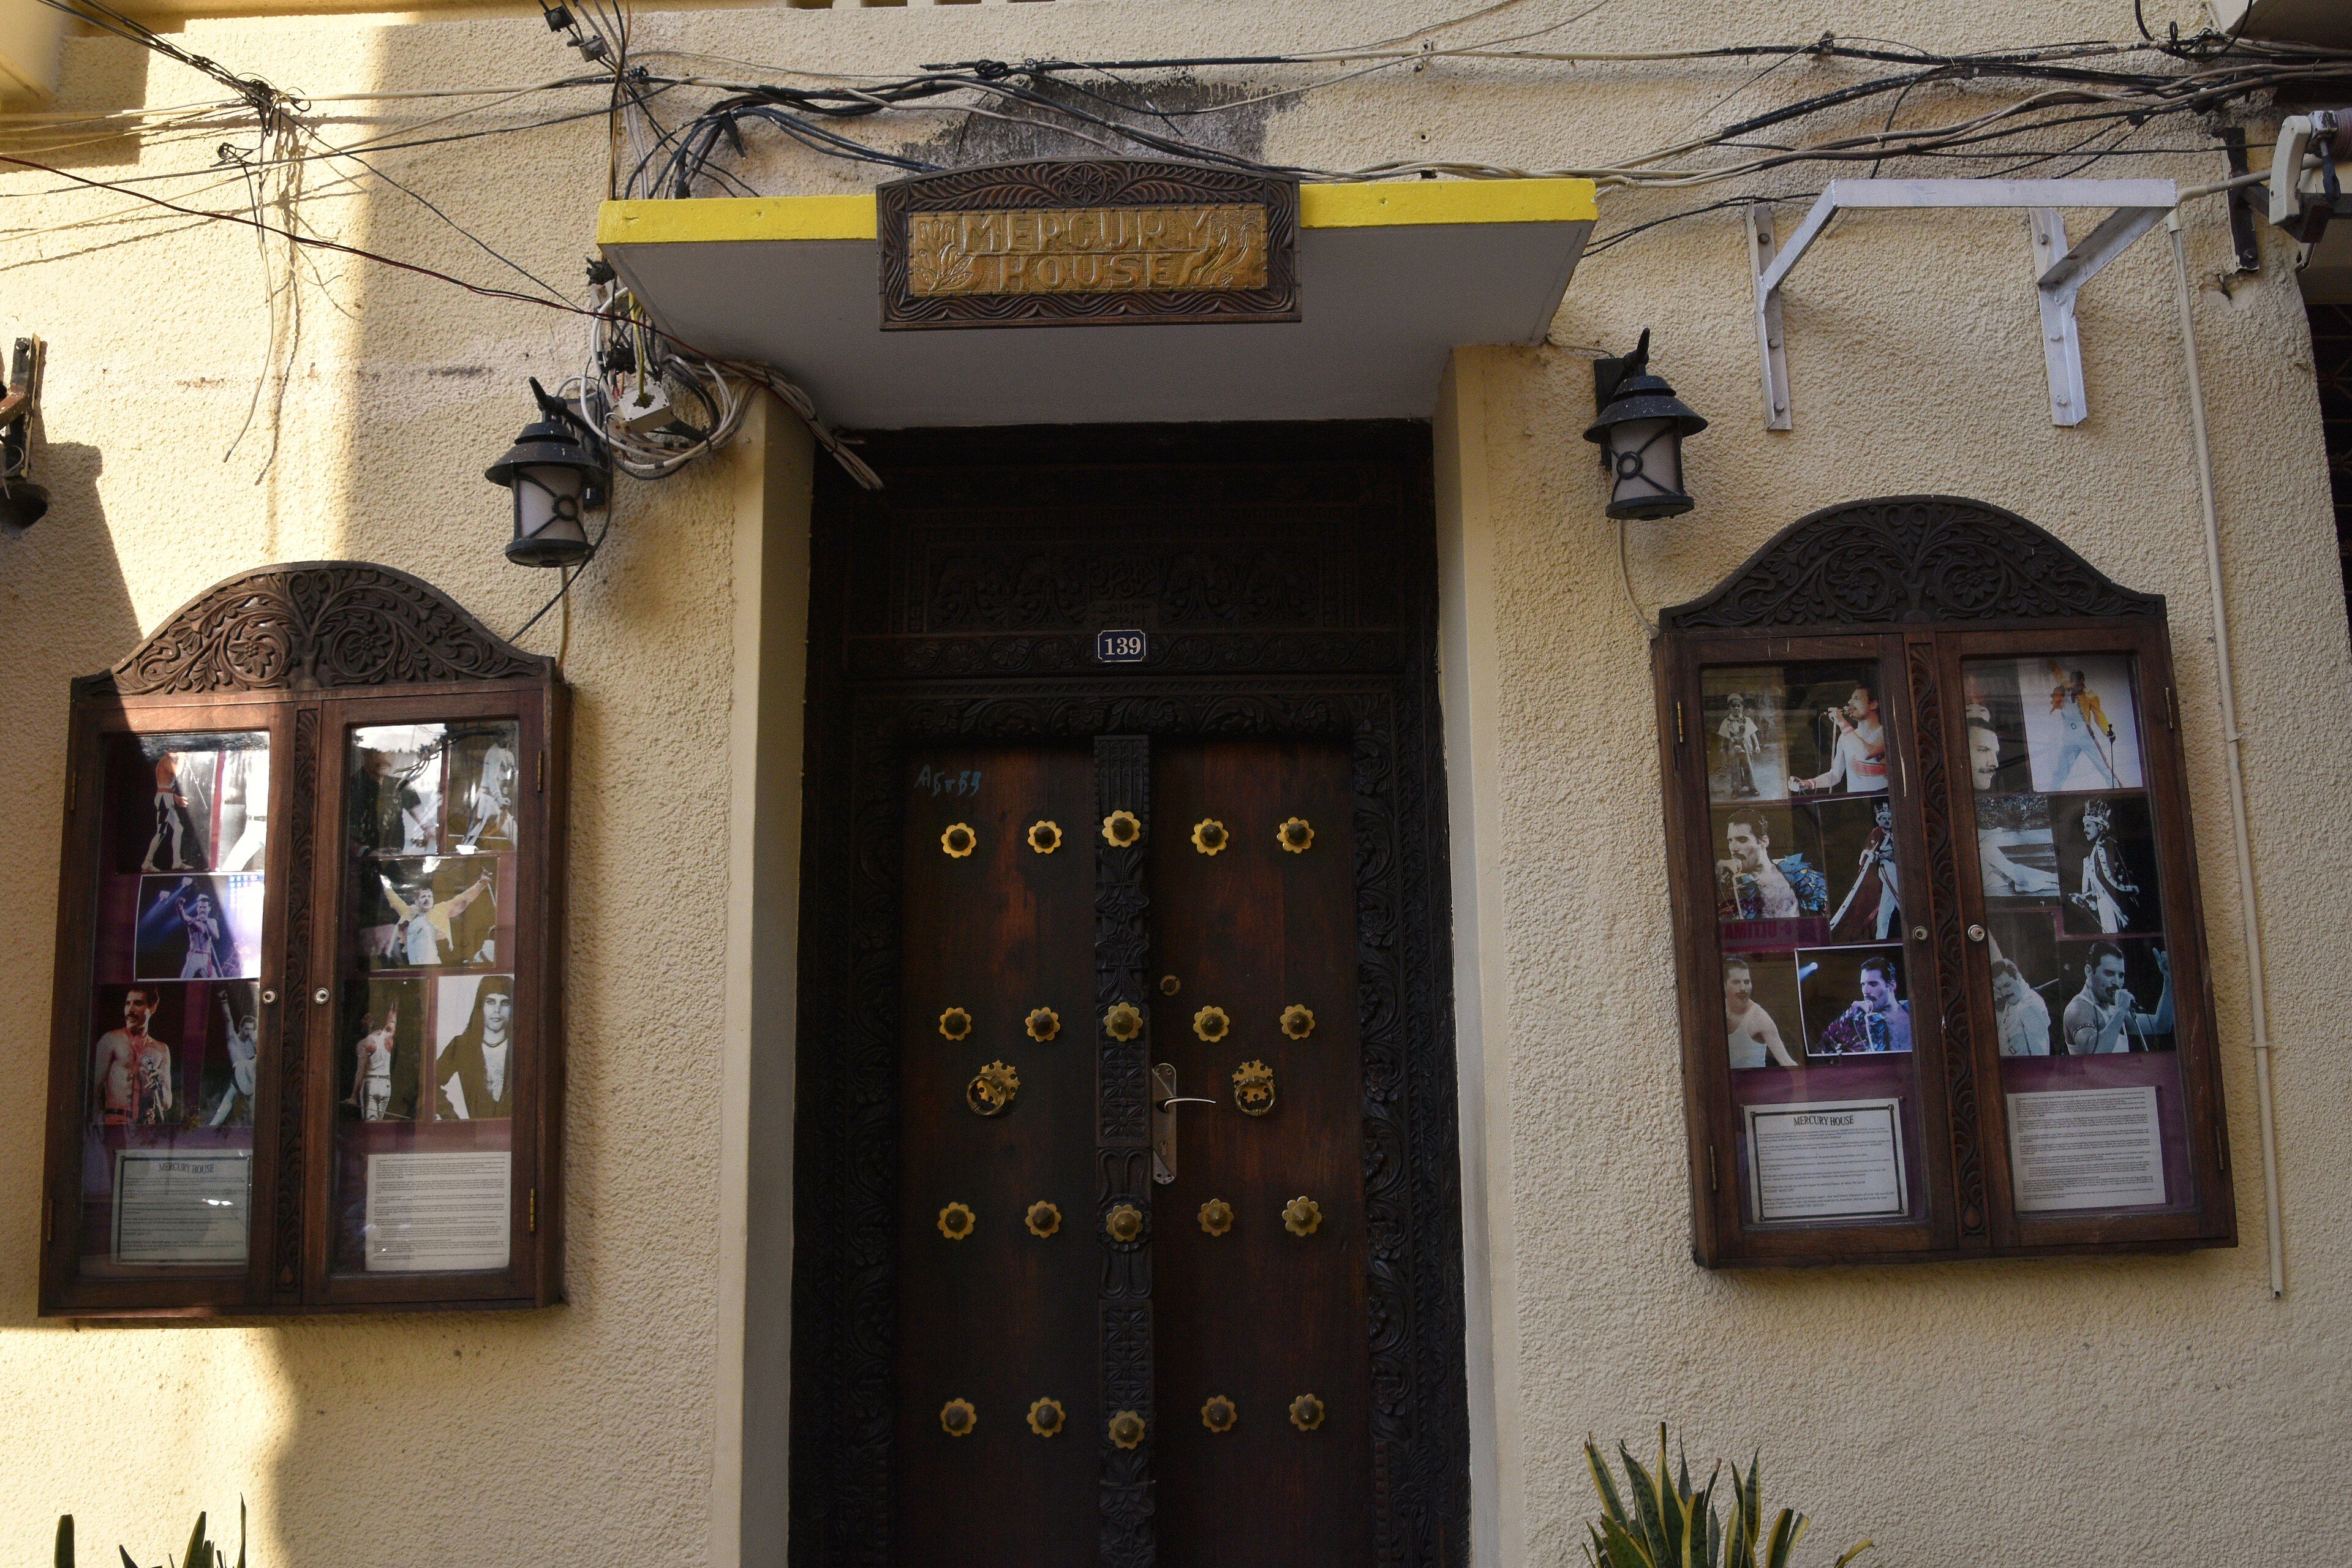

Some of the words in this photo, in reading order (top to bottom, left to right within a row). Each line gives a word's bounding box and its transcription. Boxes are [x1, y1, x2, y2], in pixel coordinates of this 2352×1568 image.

[960, 212, 1211, 251] MERCURY
[999, 254, 1175, 289] HOUSE
[1104, 636, 1142, 656] 139
[1793, 1116, 1828, 1126] MERCURY
[1830, 1115, 1854, 1126] HOUSE
[159, 1163, 190, 1173] MERCURY
[192, 1163, 214, 1174] HOUSE
